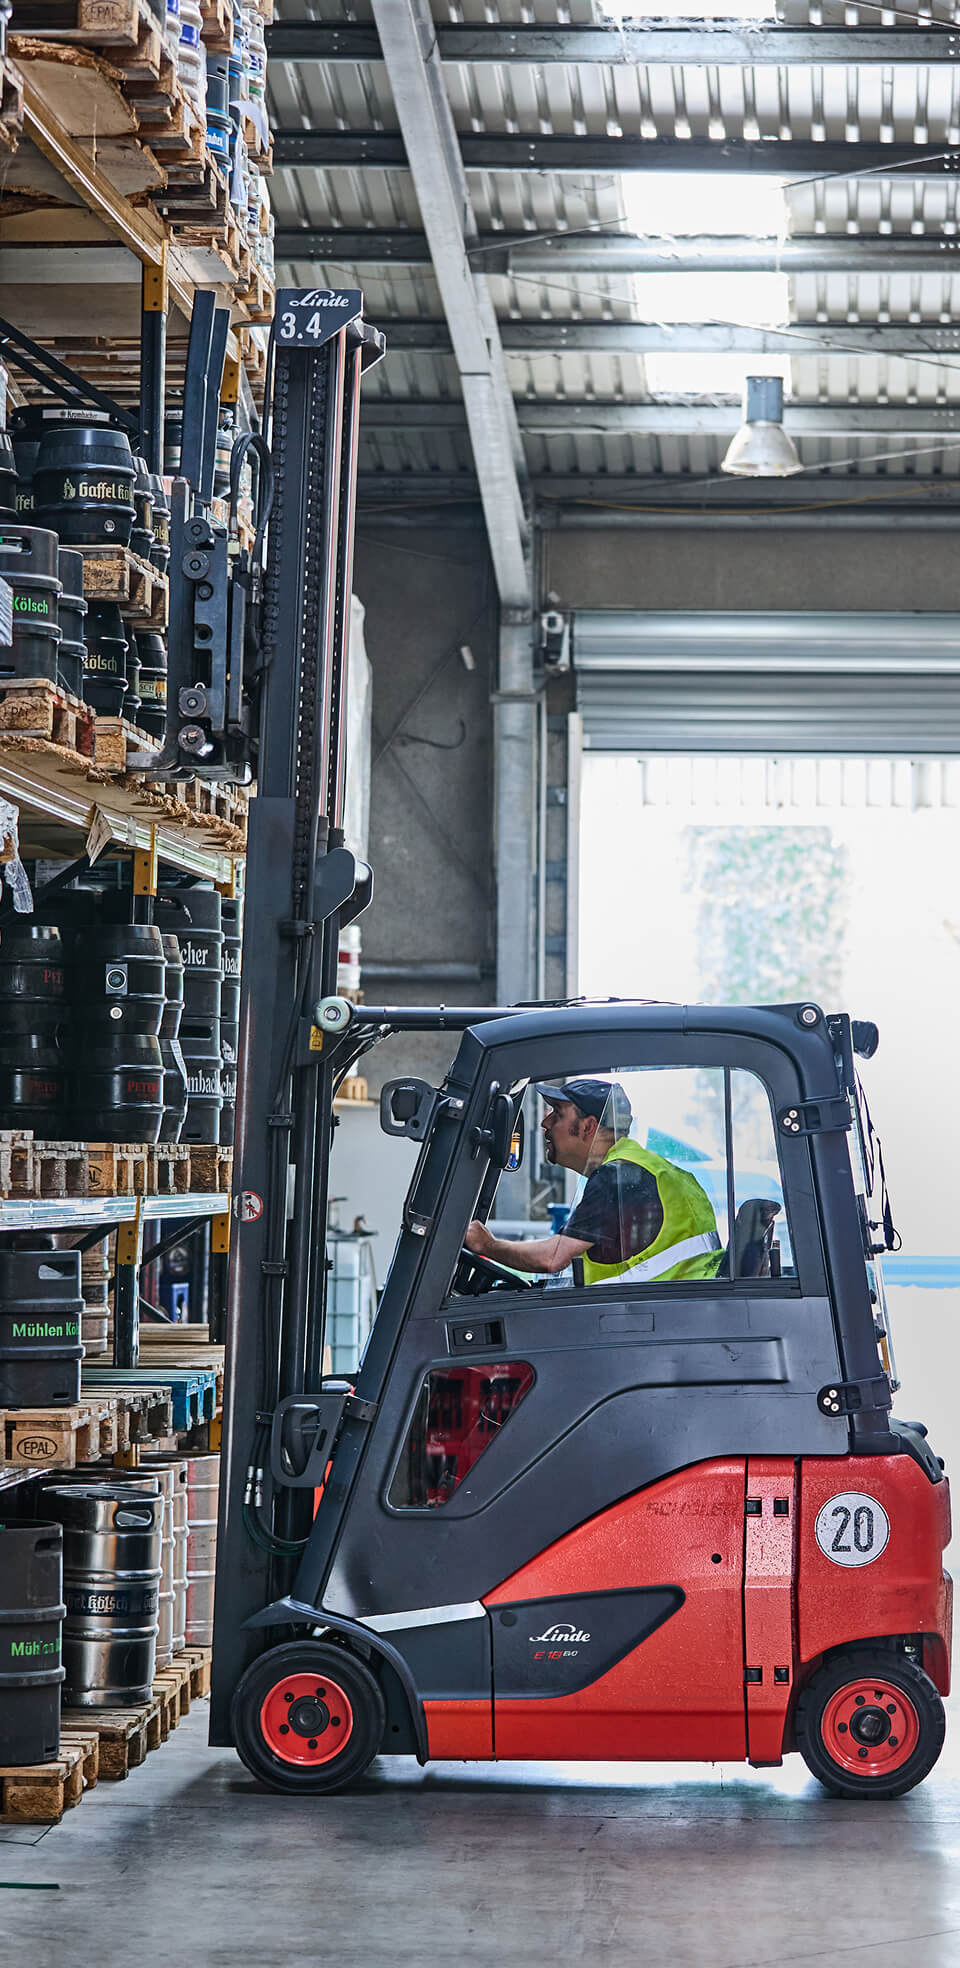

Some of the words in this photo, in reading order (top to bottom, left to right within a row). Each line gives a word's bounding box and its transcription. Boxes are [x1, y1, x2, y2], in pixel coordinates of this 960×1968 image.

[289, 289, 350, 307] Linde
[280, 311, 322, 339] 3.4
[79, 481, 116, 499] Gaffel
[16, 494, 34, 511] ffel
[140, 684, 154, 692] SCH
[180, 941, 208, 965] cher
[12, 1322, 63, 1337] Mühlen
[23, 1441, 52, 1455] EPAL
[831, 1505, 874, 1552] 20
[529, 1623, 591, 1642] Linde
